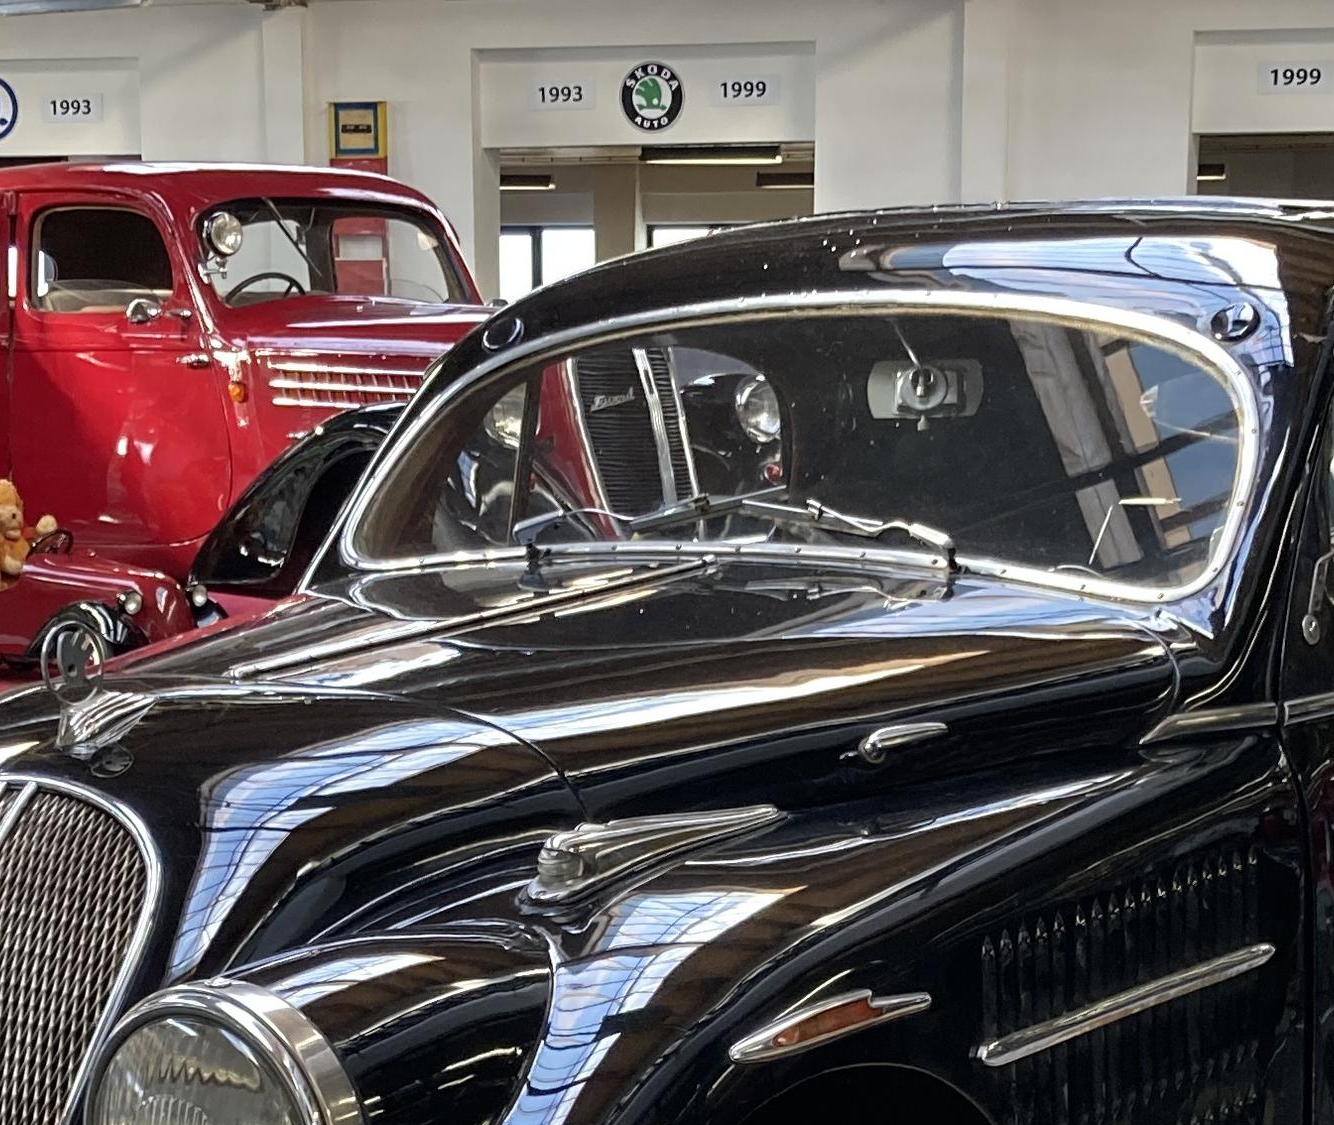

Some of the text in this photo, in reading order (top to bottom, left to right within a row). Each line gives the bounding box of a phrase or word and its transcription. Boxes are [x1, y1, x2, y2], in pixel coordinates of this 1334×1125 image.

[1270, 68, 1322, 86] 1999
[538, 86, 583, 103] 1993
[720, 81, 767, 98] 1999
[50, 99, 91, 116] 1993
[634, 116, 669, 129] AUTO
